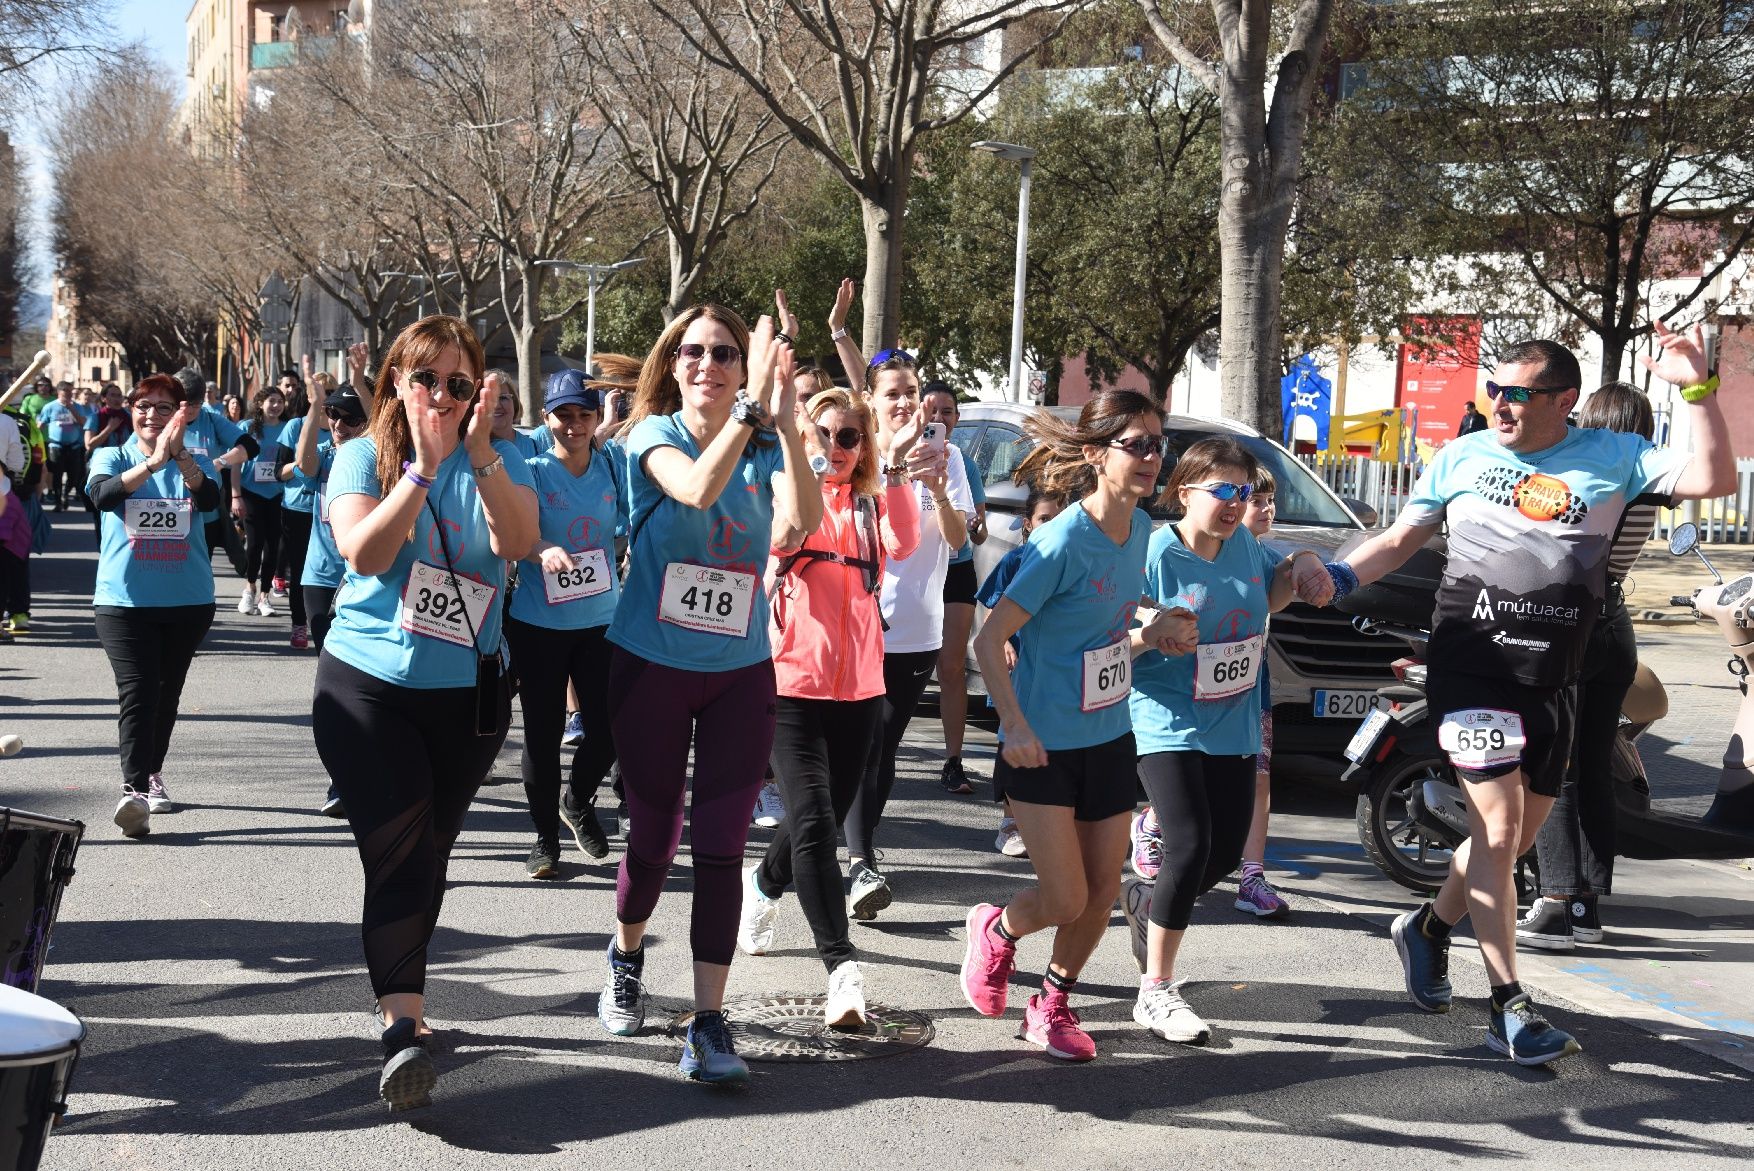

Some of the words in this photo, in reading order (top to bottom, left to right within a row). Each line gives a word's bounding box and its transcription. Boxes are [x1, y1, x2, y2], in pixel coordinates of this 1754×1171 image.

[1526, 479, 1562, 501] BRAVO
[1521, 495, 1555, 516] TRAIL
[138, 511, 178, 529] 228
[133, 552, 188, 562] MANRESA
[557, 566, 597, 589] 632
[415, 587, 465, 624] 392
[680, 585, 733, 617] 418
[1497, 598, 1580, 620] mútuacat
[1516, 613, 1530, 621] fem
[1098, 660, 1126, 691] 670
[1213, 656, 1250, 684] 669
[1328, 694, 1380, 715] 6208
[1457, 728, 1505, 752] 659
